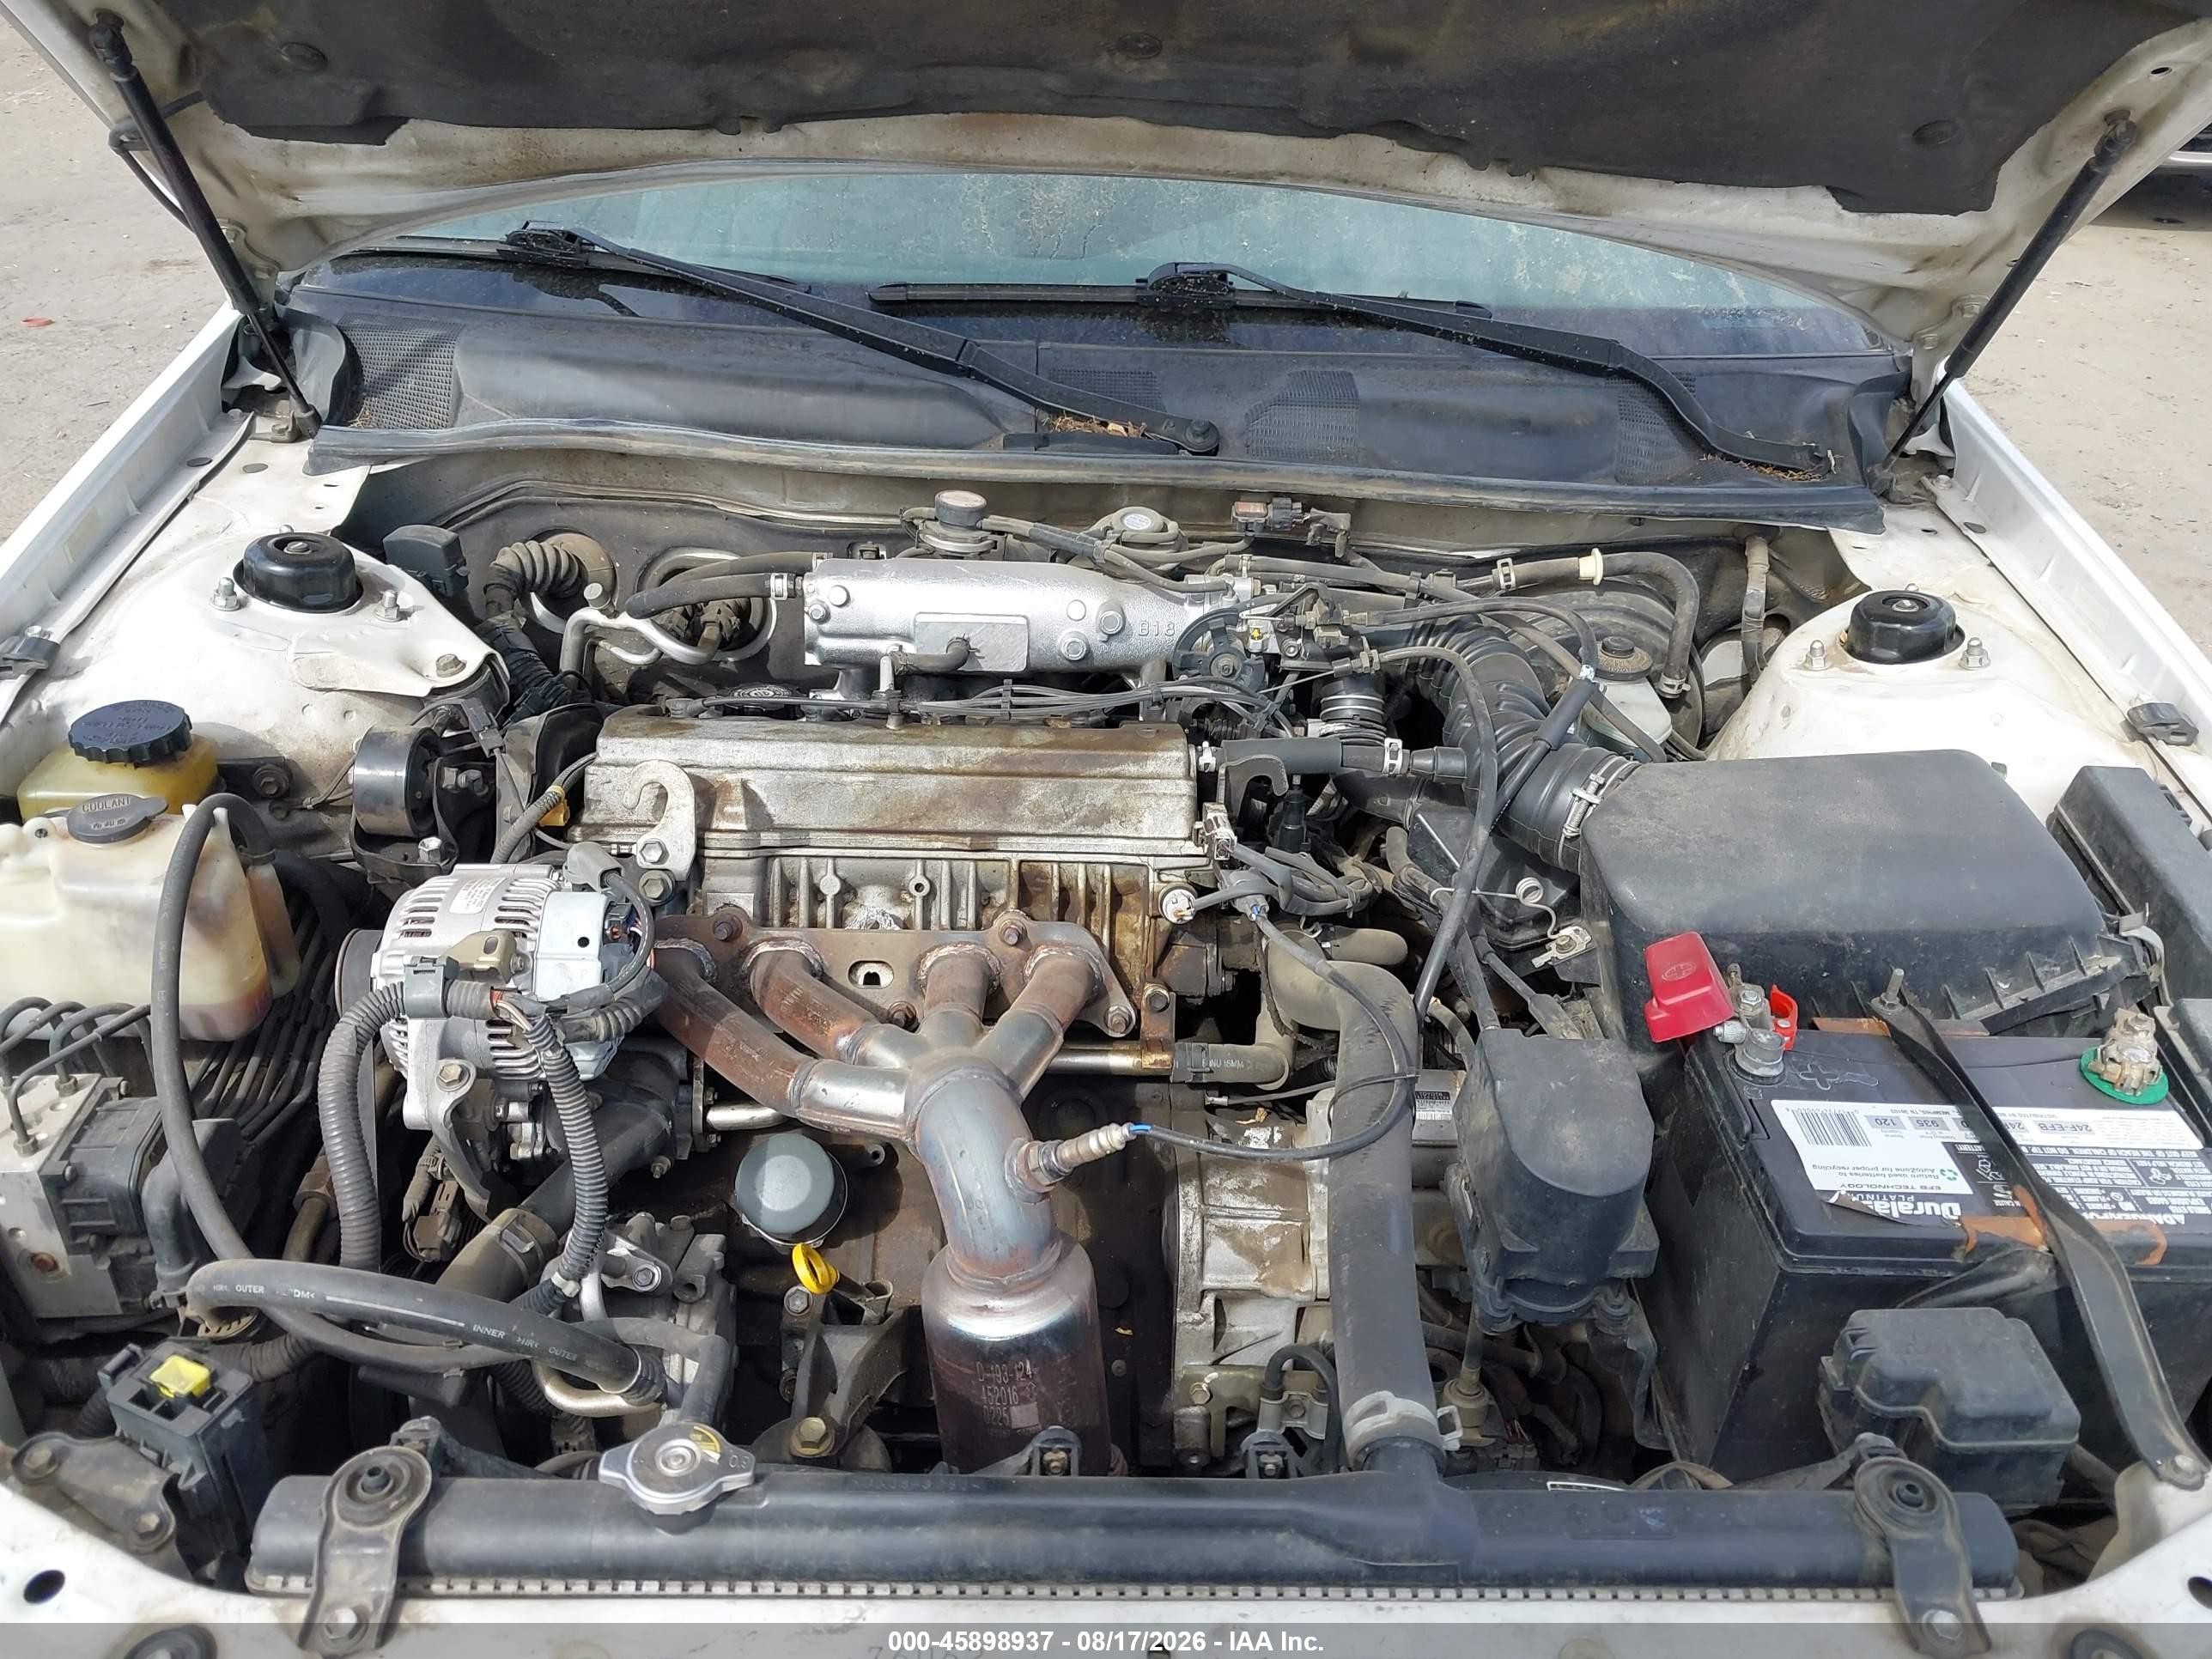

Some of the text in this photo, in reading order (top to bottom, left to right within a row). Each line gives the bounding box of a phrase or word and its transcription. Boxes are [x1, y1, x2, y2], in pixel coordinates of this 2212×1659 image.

[2038, 1122, 2092, 1132] 24F-EFB
[1847, 1193, 1914, 1202] PLATINU
[235, 1285, 264, 1293] OUTER
[472, 1323, 506, 1340] INNER
[549, 1346, 578, 1362] OUTER
